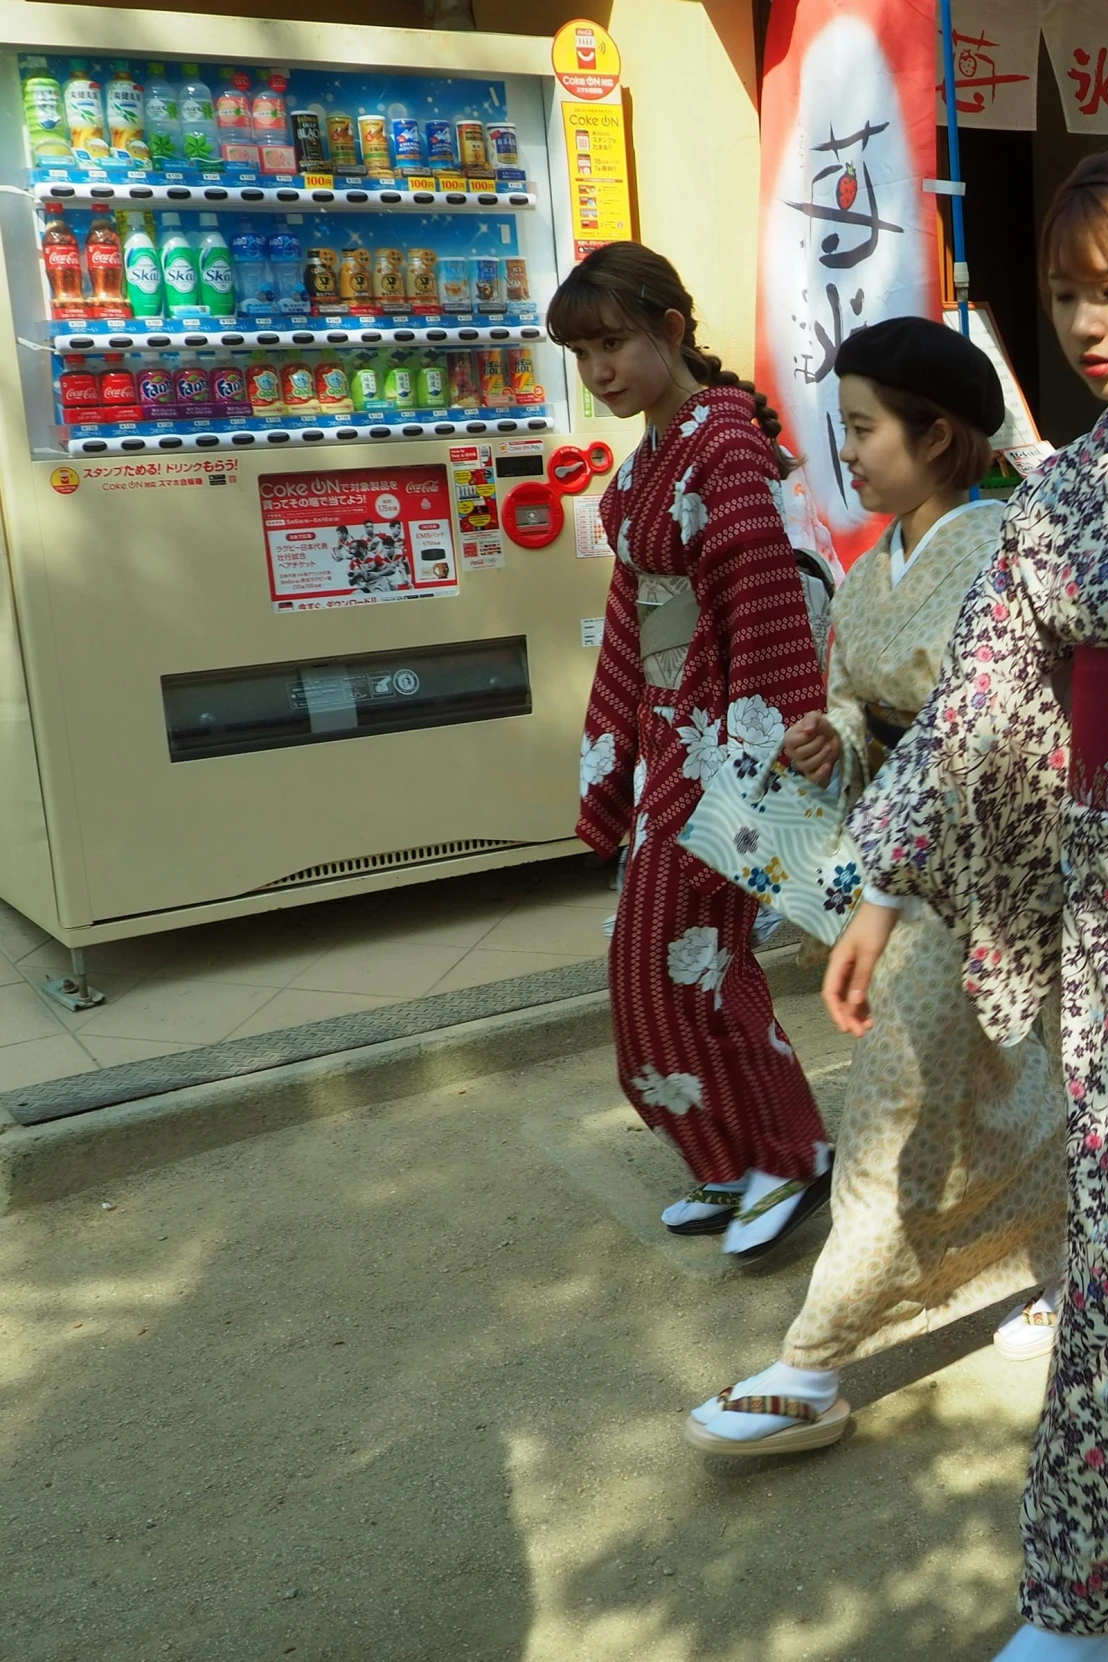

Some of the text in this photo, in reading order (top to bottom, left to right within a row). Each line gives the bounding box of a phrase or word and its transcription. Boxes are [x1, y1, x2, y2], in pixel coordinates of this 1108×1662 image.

[562, 75, 586, 86] Coke
[569, 114, 619, 127] Coke ON
[306, 176, 332, 186] 100円
[409, 179, 434, 188] 100円
[441, 180, 465, 189] 100円
[470, 181, 495, 190] 100円
[83, 459, 238, 478] スタンプためる! ドリンクもらう!
[102, 481, 127, 491] Coke
[260, 482, 309, 498] Coke
[262, 494, 367, 511] 買ってその場で当てよう!
